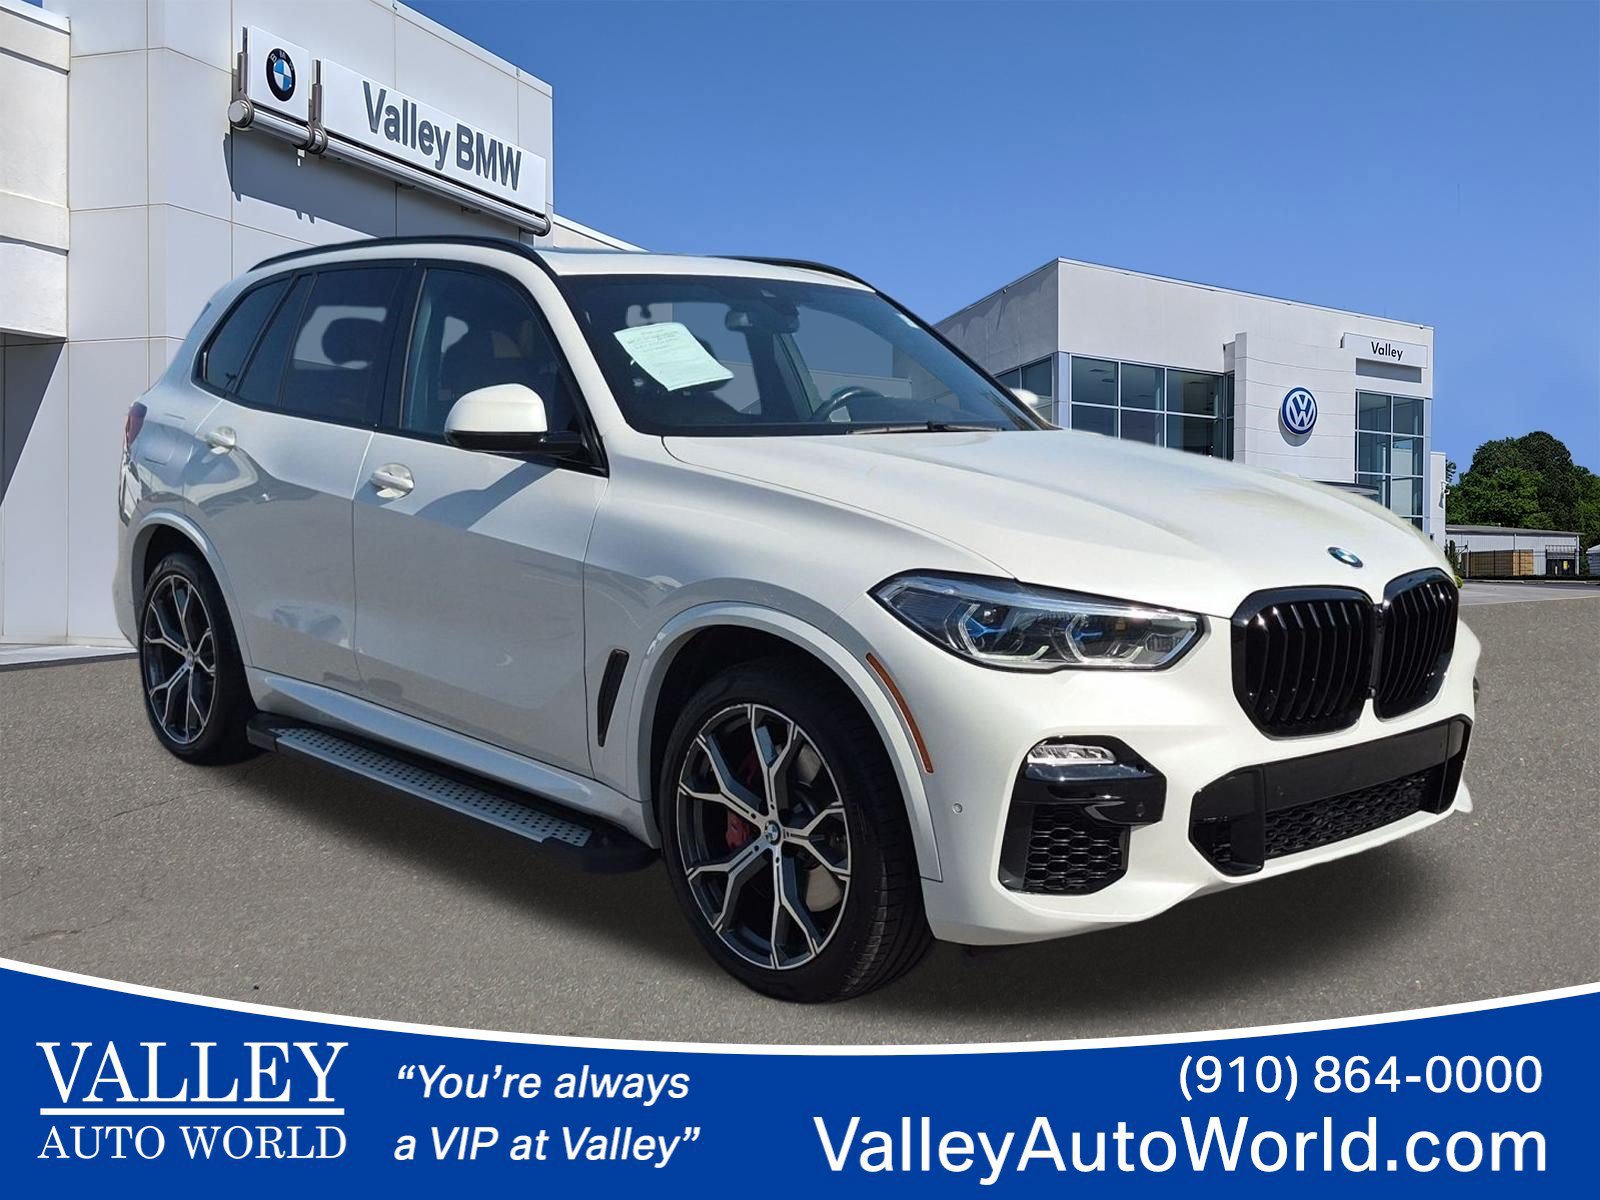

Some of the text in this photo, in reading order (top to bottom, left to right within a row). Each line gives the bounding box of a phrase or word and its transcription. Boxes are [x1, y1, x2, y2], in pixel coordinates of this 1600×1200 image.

[362, 80, 522, 191] Valley BMW
[1371, 341, 1404, 361] Valley
